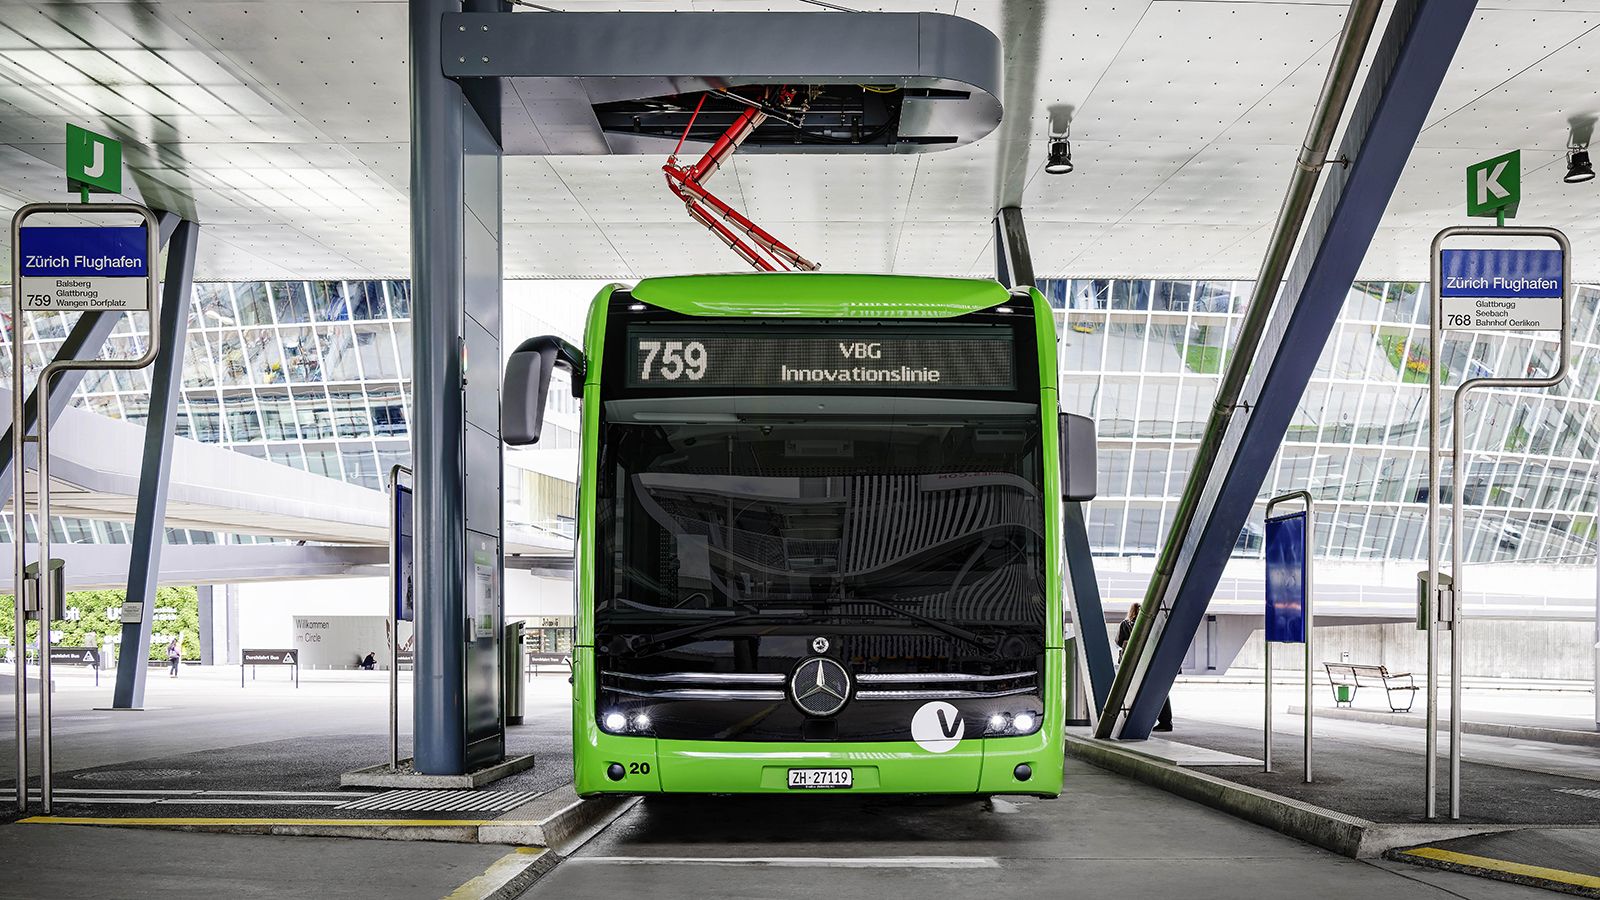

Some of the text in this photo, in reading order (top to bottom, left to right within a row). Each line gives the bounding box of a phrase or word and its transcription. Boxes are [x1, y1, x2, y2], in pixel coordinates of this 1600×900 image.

[83, 140, 105, 178] J
[1476, 160, 1511, 205] K
[26, 255, 142, 271] Zürich Flughafen
[56, 280, 91, 289] Balsberg
[1446, 276, 1558, 292] Zürich Flughafen
[26, 294, 51, 306] 759
[56, 289, 98, 299] Glattbrugg
[56, 299, 126, 309] Wangen Dorfplatz
[1475, 300, 1516, 310] Glattbrugg
[1447, 314, 1472, 326] 768
[1475, 310, 1509, 318] Seebach
[1475, 319, 1540, 327] Bahnhof Oerlikon
[839, 342, 882, 359] VBG
[639, 341, 708, 381] 759
[781, 364, 941, 382] Innovationslinie
[296, 619, 330, 629] Willkommen
[304, 632, 321, 642] Circle
[629, 762, 651, 775] 20
